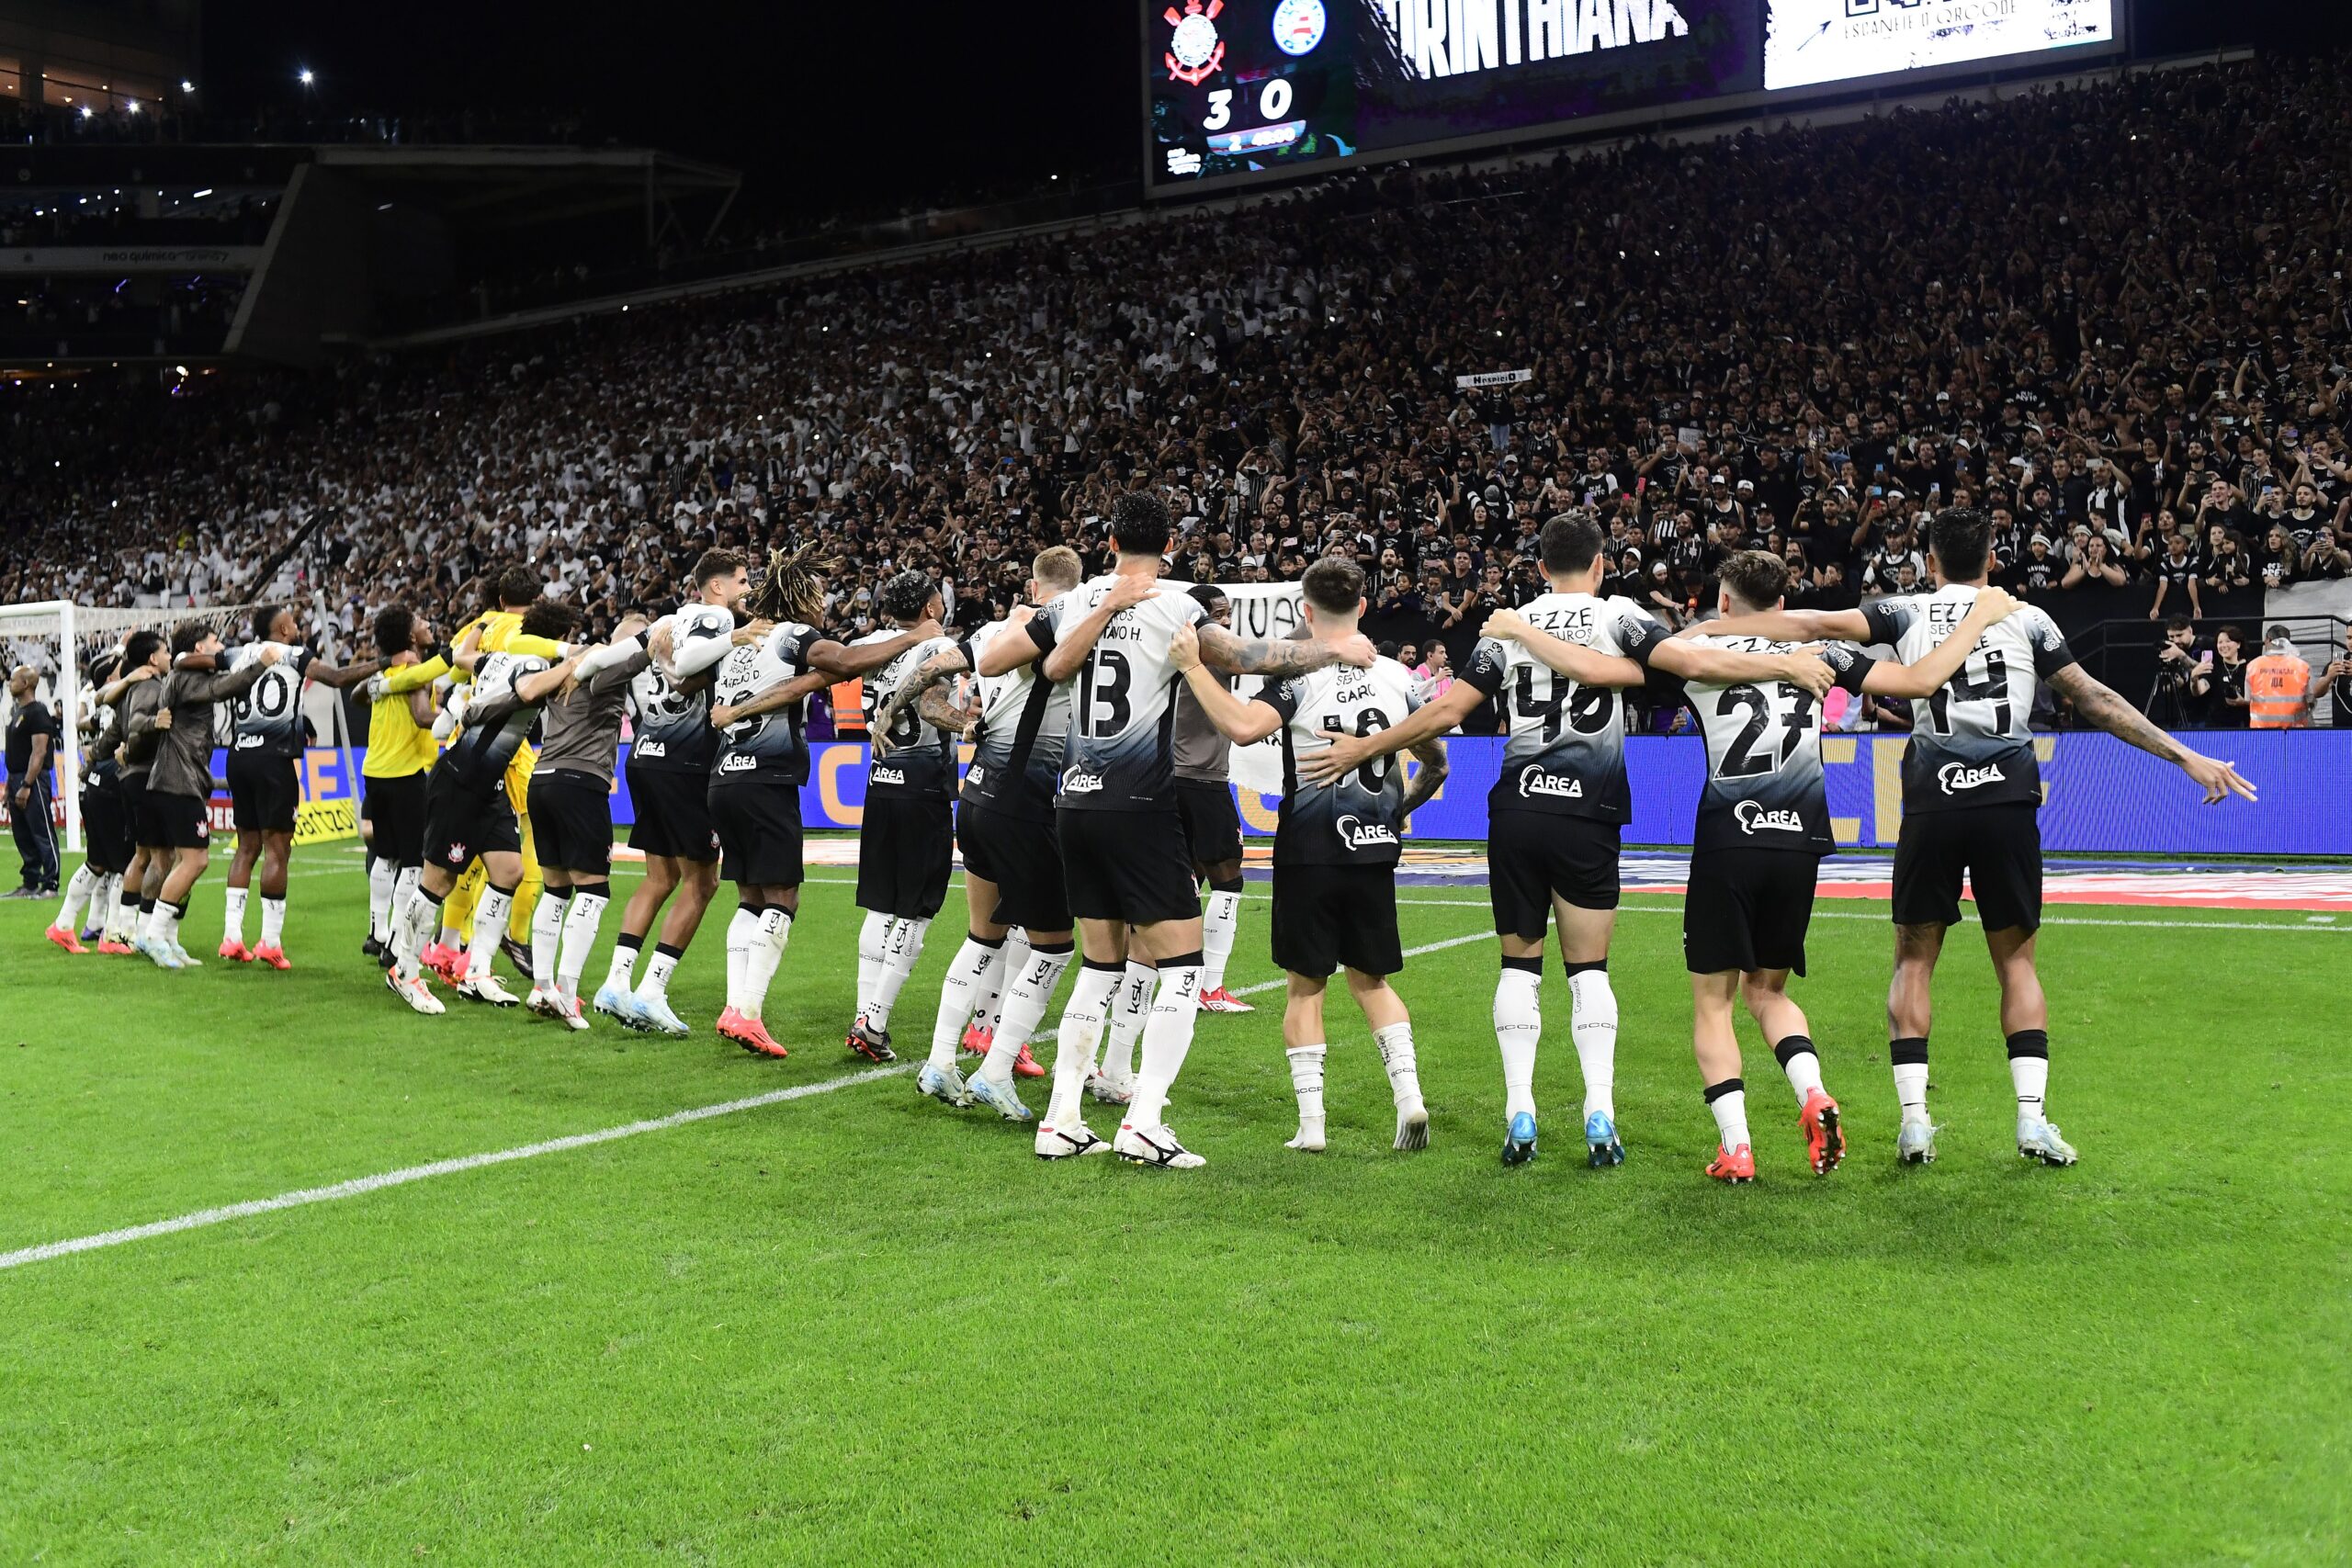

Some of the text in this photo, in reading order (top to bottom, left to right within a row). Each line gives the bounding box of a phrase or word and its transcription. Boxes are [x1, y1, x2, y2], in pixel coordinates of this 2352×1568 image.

[1203, 78, 1293, 130] 3 0
[1529, 607, 1592, 630] EZZE
[1078, 649, 1131, 740] 13
[1516, 666, 1614, 746] 46
[1713, 682, 1816, 781] 27
[639, 741, 665, 754] AREA
[723, 754, 757, 768] AREA
[874, 766, 904, 781] AREA
[1952, 763, 2007, 784] AREA
[1531, 774, 1583, 795] AREA
[1755, 809, 1803, 828] AREA
[1352, 825, 1398, 842] AREA
[890, 919, 910, 954] ksk
[1175, 969, 1197, 998] ksk
[1127, 977, 1146, 1015] ksk
[1063, 1012, 1097, 1022] CCP
[1496, 1023, 1539, 1032] SCCP
